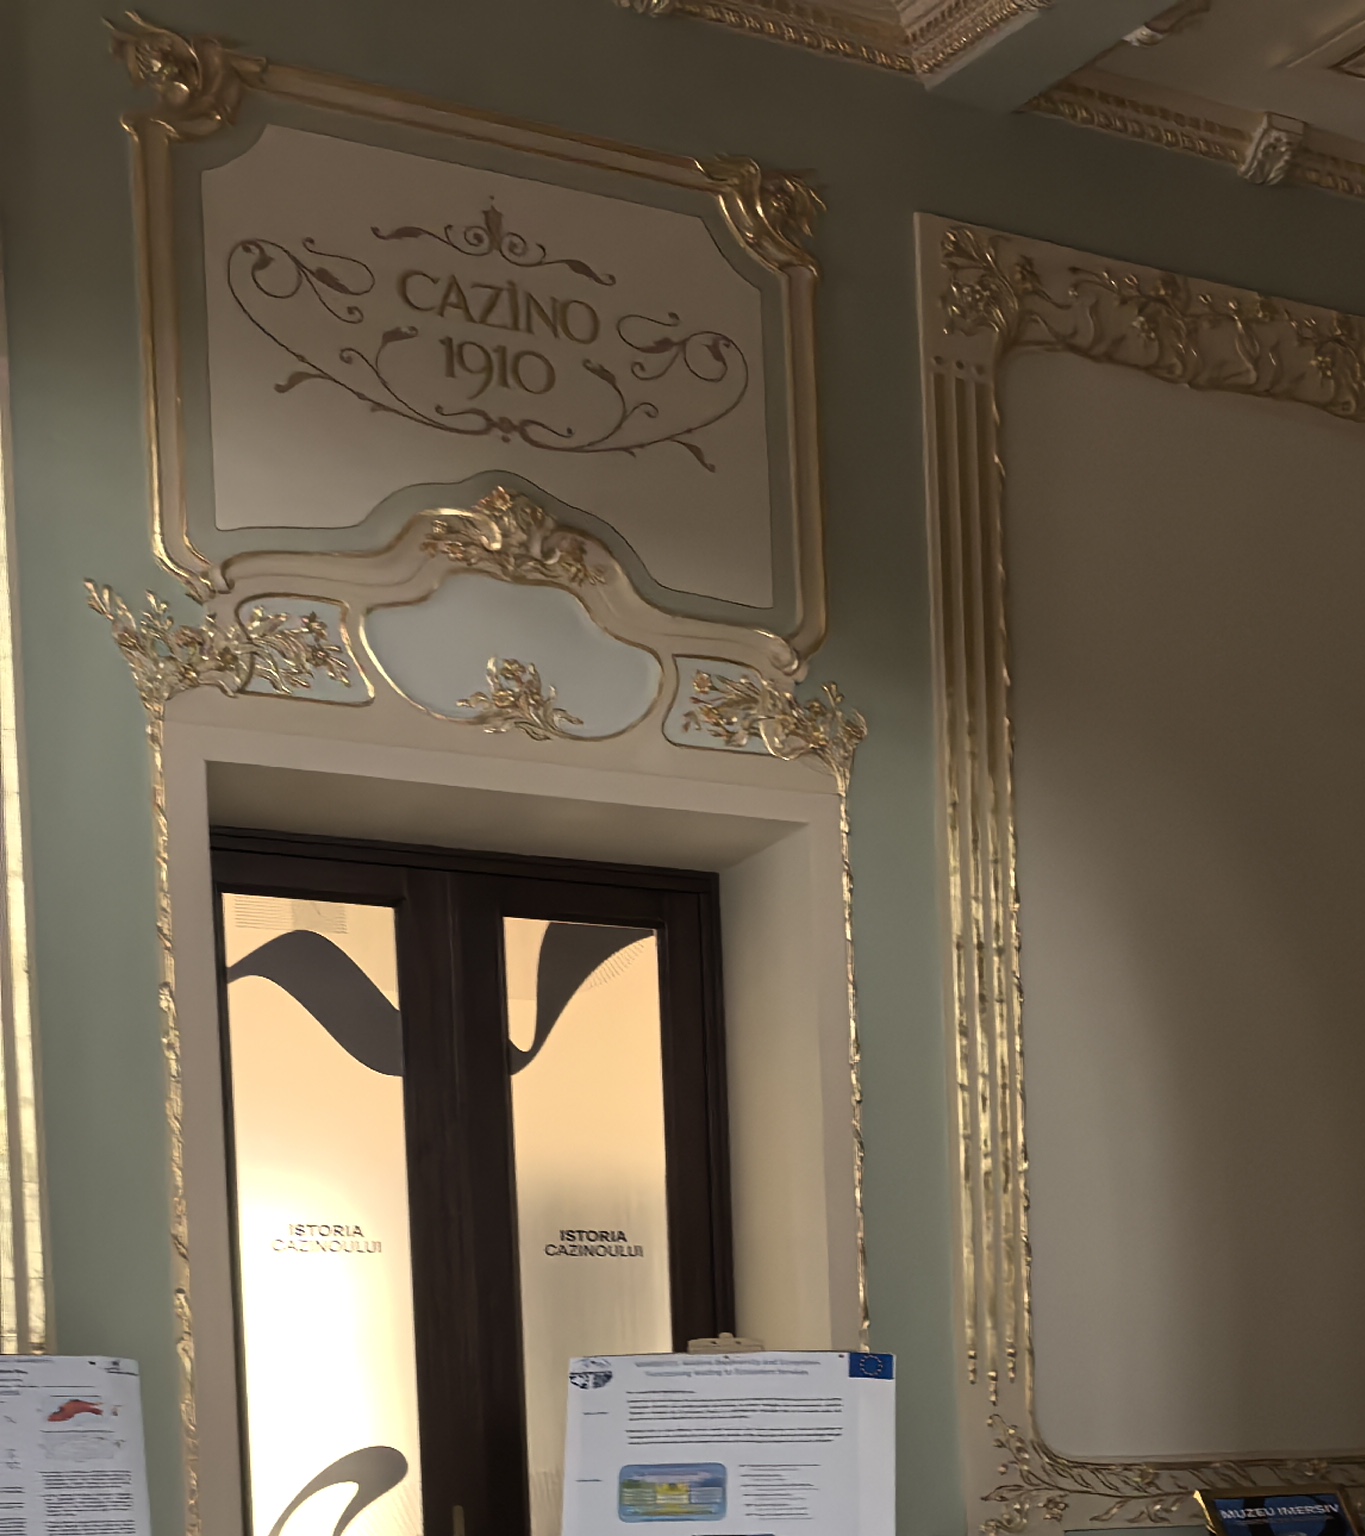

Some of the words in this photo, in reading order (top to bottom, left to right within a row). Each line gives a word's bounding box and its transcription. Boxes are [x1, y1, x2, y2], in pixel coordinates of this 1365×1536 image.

[397, 267, 600, 345] CAZINO
[439, 335, 556, 399] 1910
[289, 1224, 364, 1237] ISTORIA
[560, 1229, 627, 1242] ISTORIA
[272, 1239, 382, 1253] CAZINOULUI
[544, 1244, 644, 1257] CAZINOULUI
[1220, 1507, 1276, 1519] MUZEU
[1277, 1504, 1339, 1515] IMERSIV
